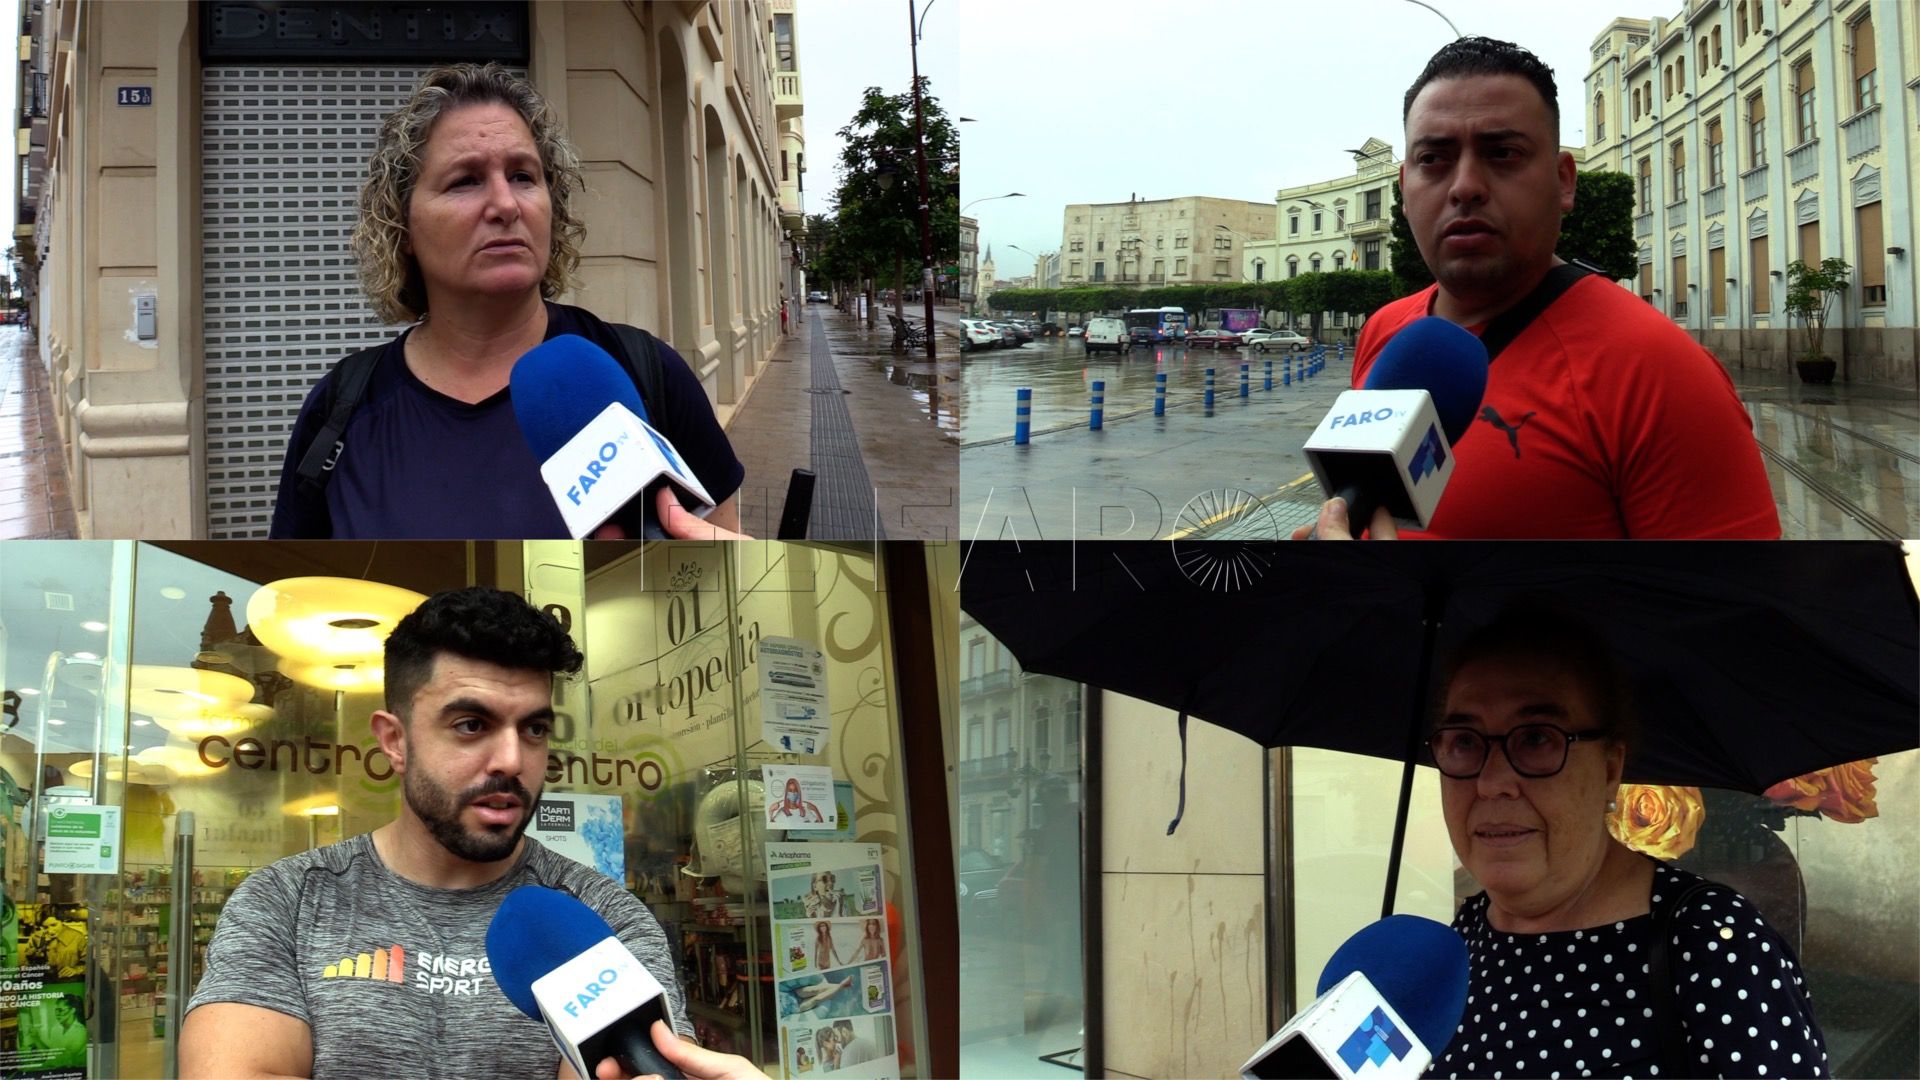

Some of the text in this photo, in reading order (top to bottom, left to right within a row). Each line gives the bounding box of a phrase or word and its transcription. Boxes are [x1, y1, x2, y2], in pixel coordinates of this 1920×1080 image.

[214, 5, 514, 42] DENTIX
[120, 89, 141, 103] 15
[1330, 407, 1394, 430] FARO
[566, 441, 618, 507] FARO
[613, 615, 761, 725] ortopedia
[197, 735, 395, 781] centro
[545, 752, 662, 792] entro
[540, 814, 571, 823] DERM
[417, 951, 492, 977] ENERG
[0, 994, 16, 1002] NDO
[29, 991, 65, 1000] HISTORIA
[416, 971, 484, 996] SPORT
[563, 968, 618, 1018] FARO
